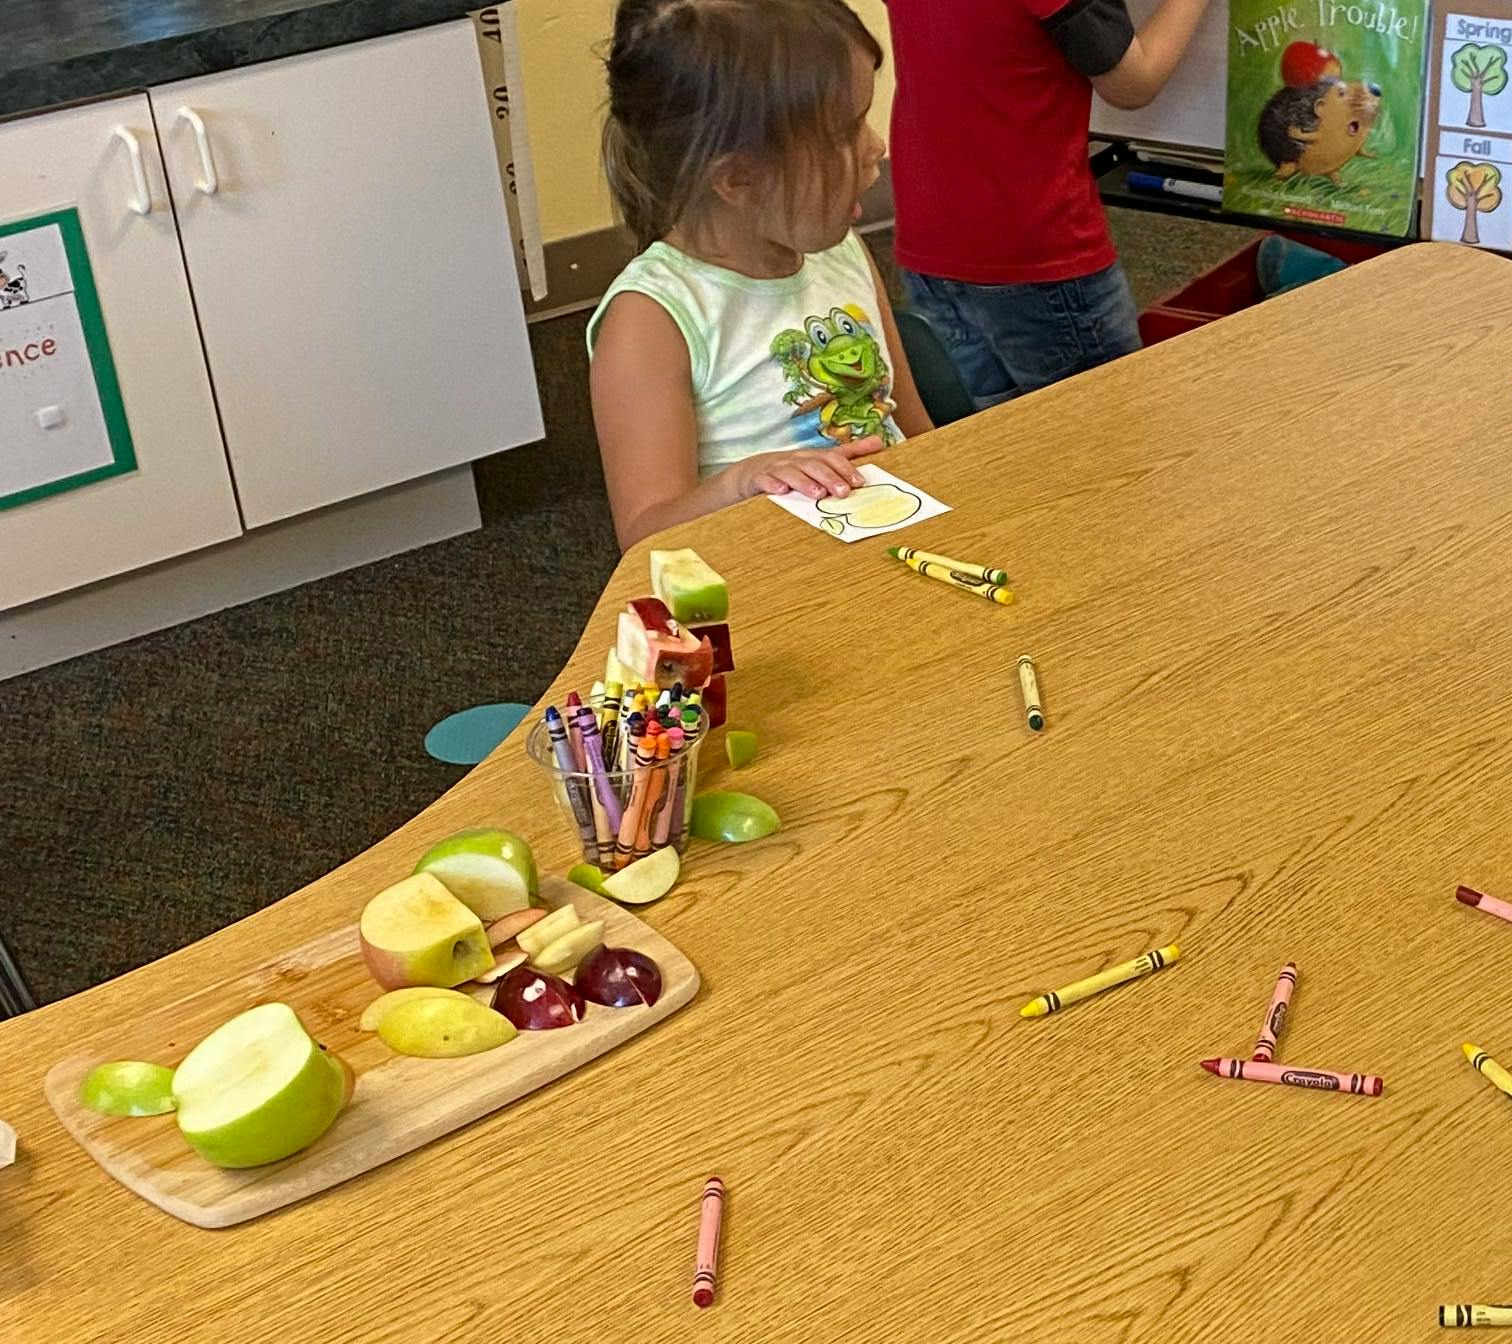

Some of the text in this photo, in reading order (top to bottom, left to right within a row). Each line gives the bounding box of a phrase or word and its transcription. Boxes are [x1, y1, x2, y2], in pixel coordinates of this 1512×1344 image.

[1235, 6, 1305, 57] Apple
[1457, 18, 1512, 43] Spring
[1463, 138, 1492, 156] Fall
[1290, 208, 1345, 225] SCHOLASTIC
[1284, 1072, 1333, 1089] Crayola
